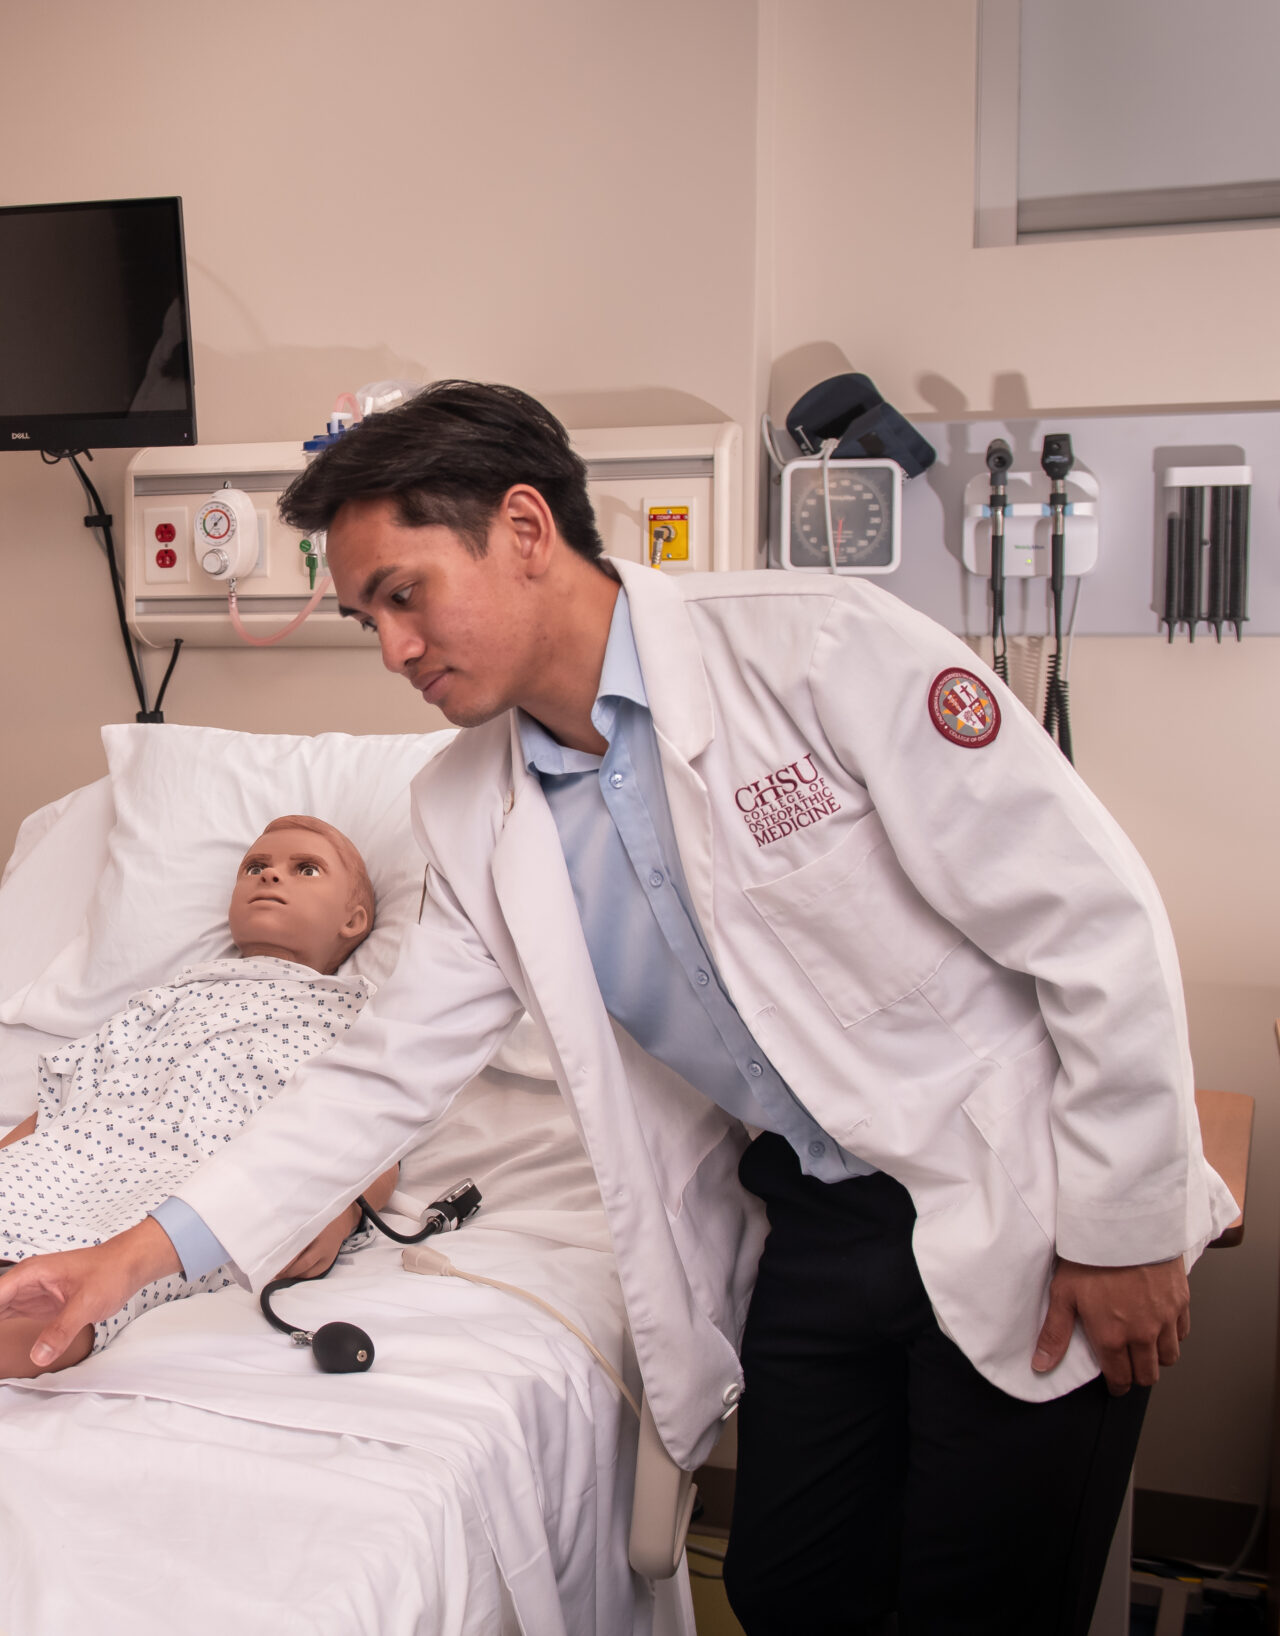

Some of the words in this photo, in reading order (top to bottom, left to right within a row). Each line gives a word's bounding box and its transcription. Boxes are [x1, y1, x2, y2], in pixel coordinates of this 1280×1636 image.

[11, 432, 30, 440] DELL
[734, 752, 819, 813] CHSU
[743, 790, 805, 824] COLLEGE
[808, 777, 826, 793] OF
[748, 786, 833, 834] OSTEOPATHIC
[752, 796, 841, 848] MEDICINE
